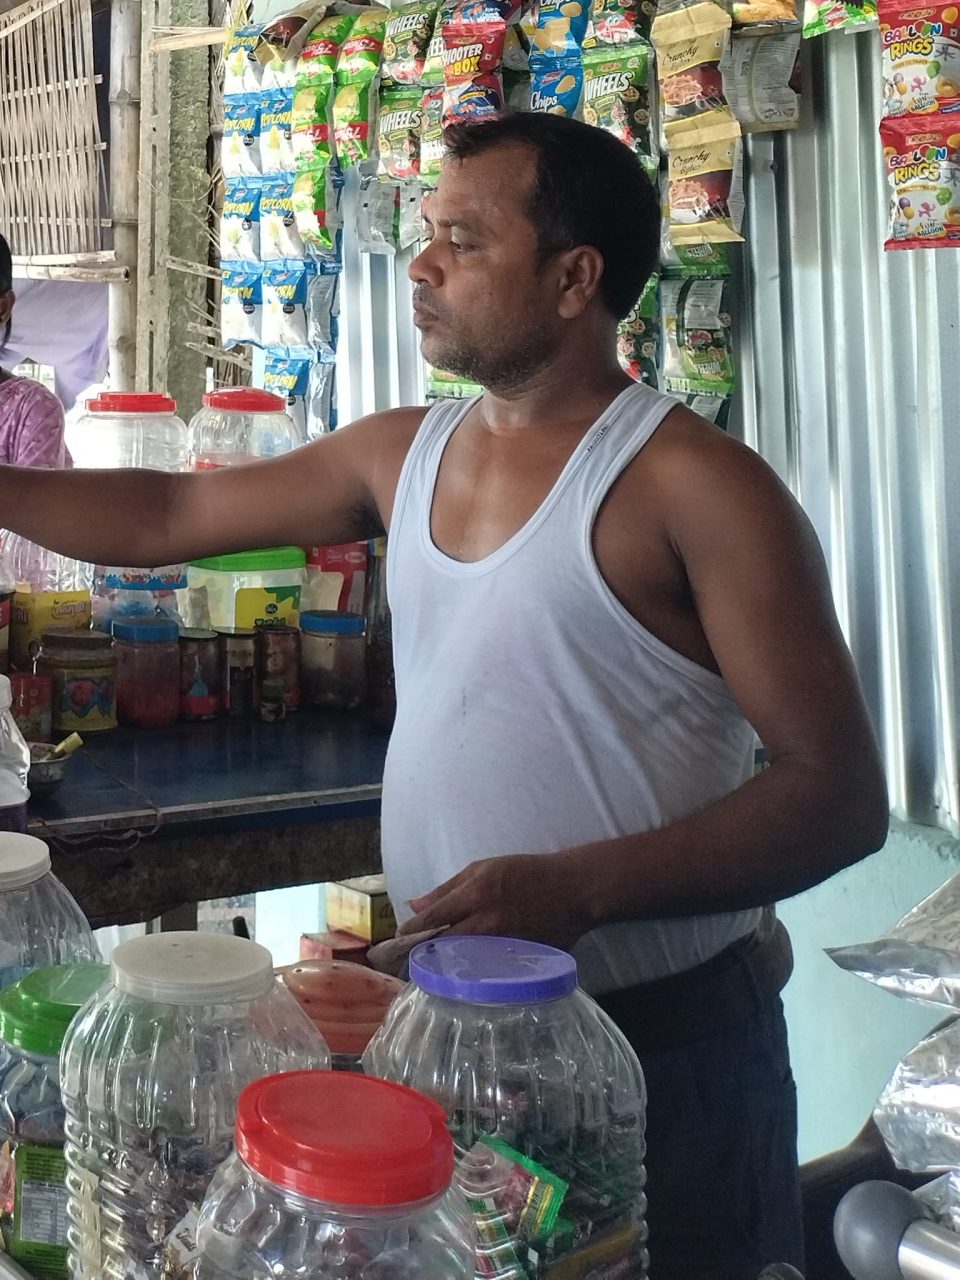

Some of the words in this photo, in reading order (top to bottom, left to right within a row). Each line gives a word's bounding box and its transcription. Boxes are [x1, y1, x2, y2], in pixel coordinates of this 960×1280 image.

[386, 11, 431, 37] WHEELS
[662, 44, 699, 67] Crunchy
[890, 35, 935, 61] RINGS
[453, 56, 481, 76] BOX
[583, 70, 634, 102] WHEELS
[530, 91, 559, 111] Chips
[379, 109, 423, 132] WHEELS
[672, 149, 711, 169] Crunchy
[894, 162, 942, 186] RINGS
